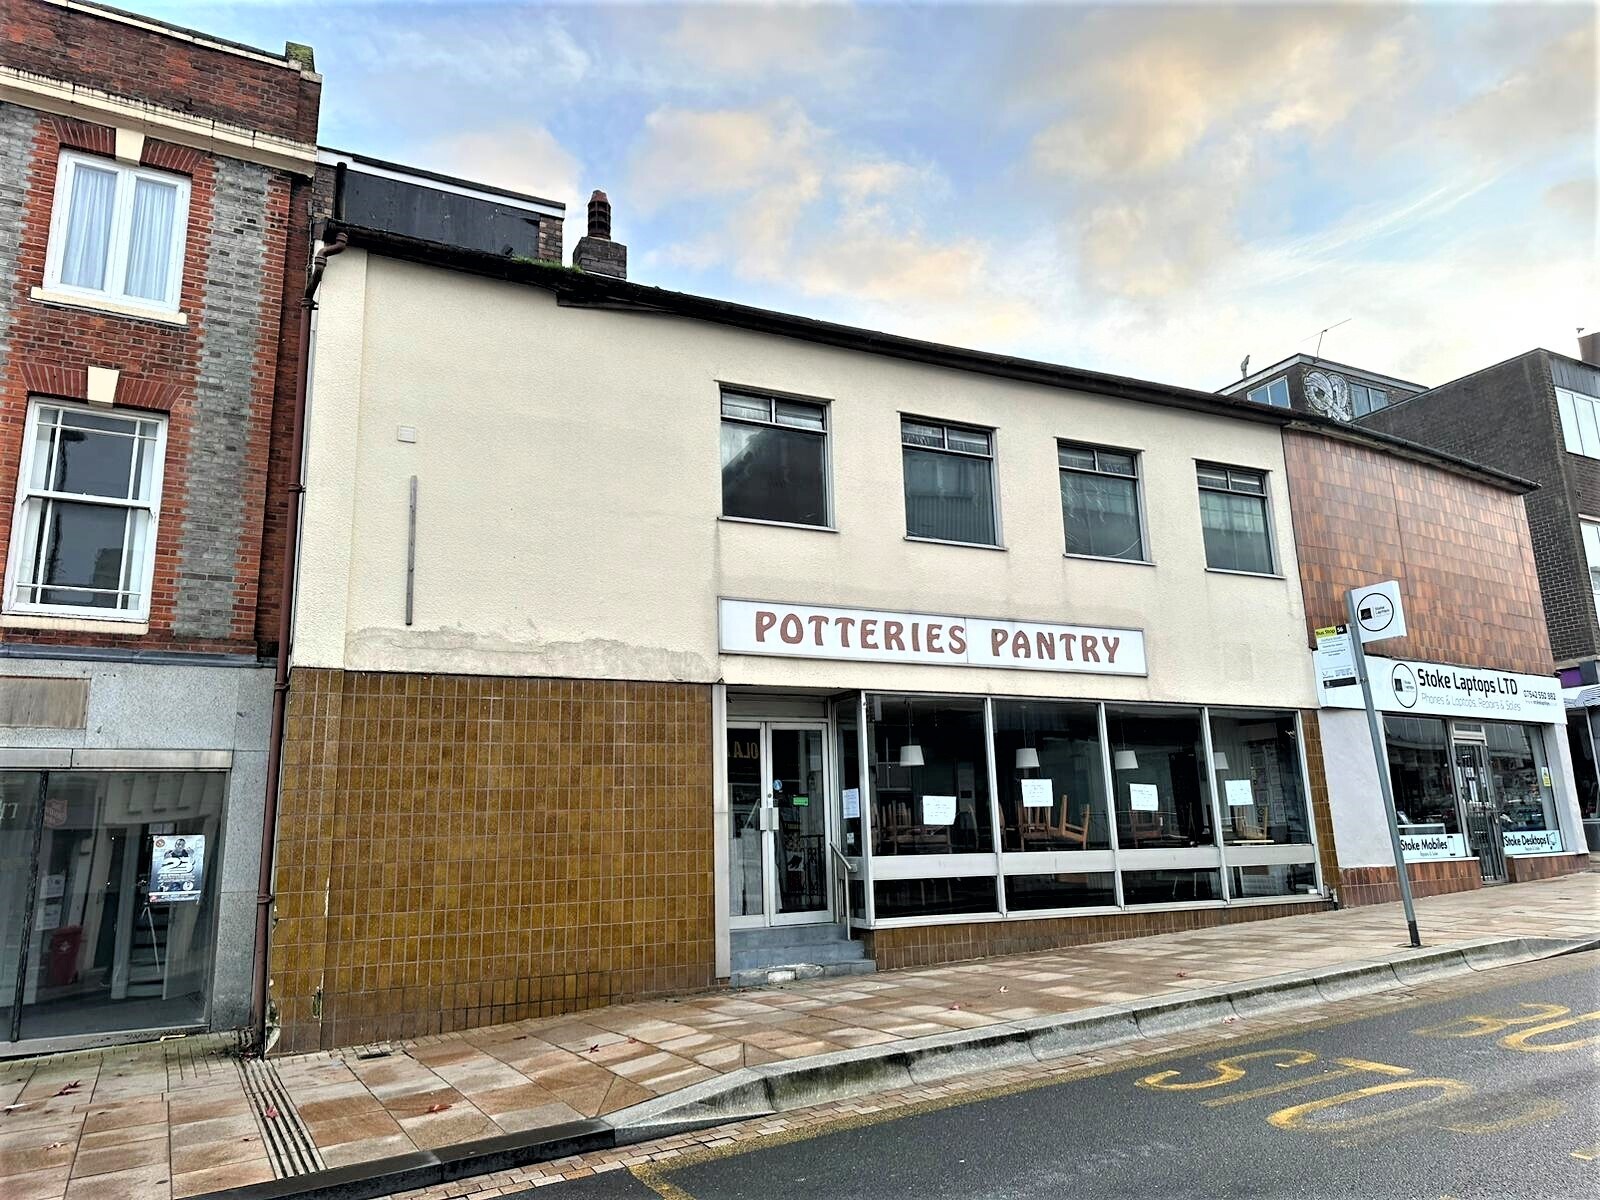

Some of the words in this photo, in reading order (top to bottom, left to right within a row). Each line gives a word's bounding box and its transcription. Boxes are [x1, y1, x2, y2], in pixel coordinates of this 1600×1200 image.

[755, 610, 967, 655] POTTERIES
[990, 628, 1120, 664] PANTRY
[1417, 668, 1451, 689] Stoke
[1453, 671, 1496, 698] Laptops
[1496, 676, 1518, 695] LTD
[1421, 692, 1445, 705] Phones
[1400, 837, 1420, 851] Stoke
[1420, 837, 1448, 850] Mobiles
[1503, 834, 1521, 847] Stoke
[1521, 833, 1547, 848] Desktops
